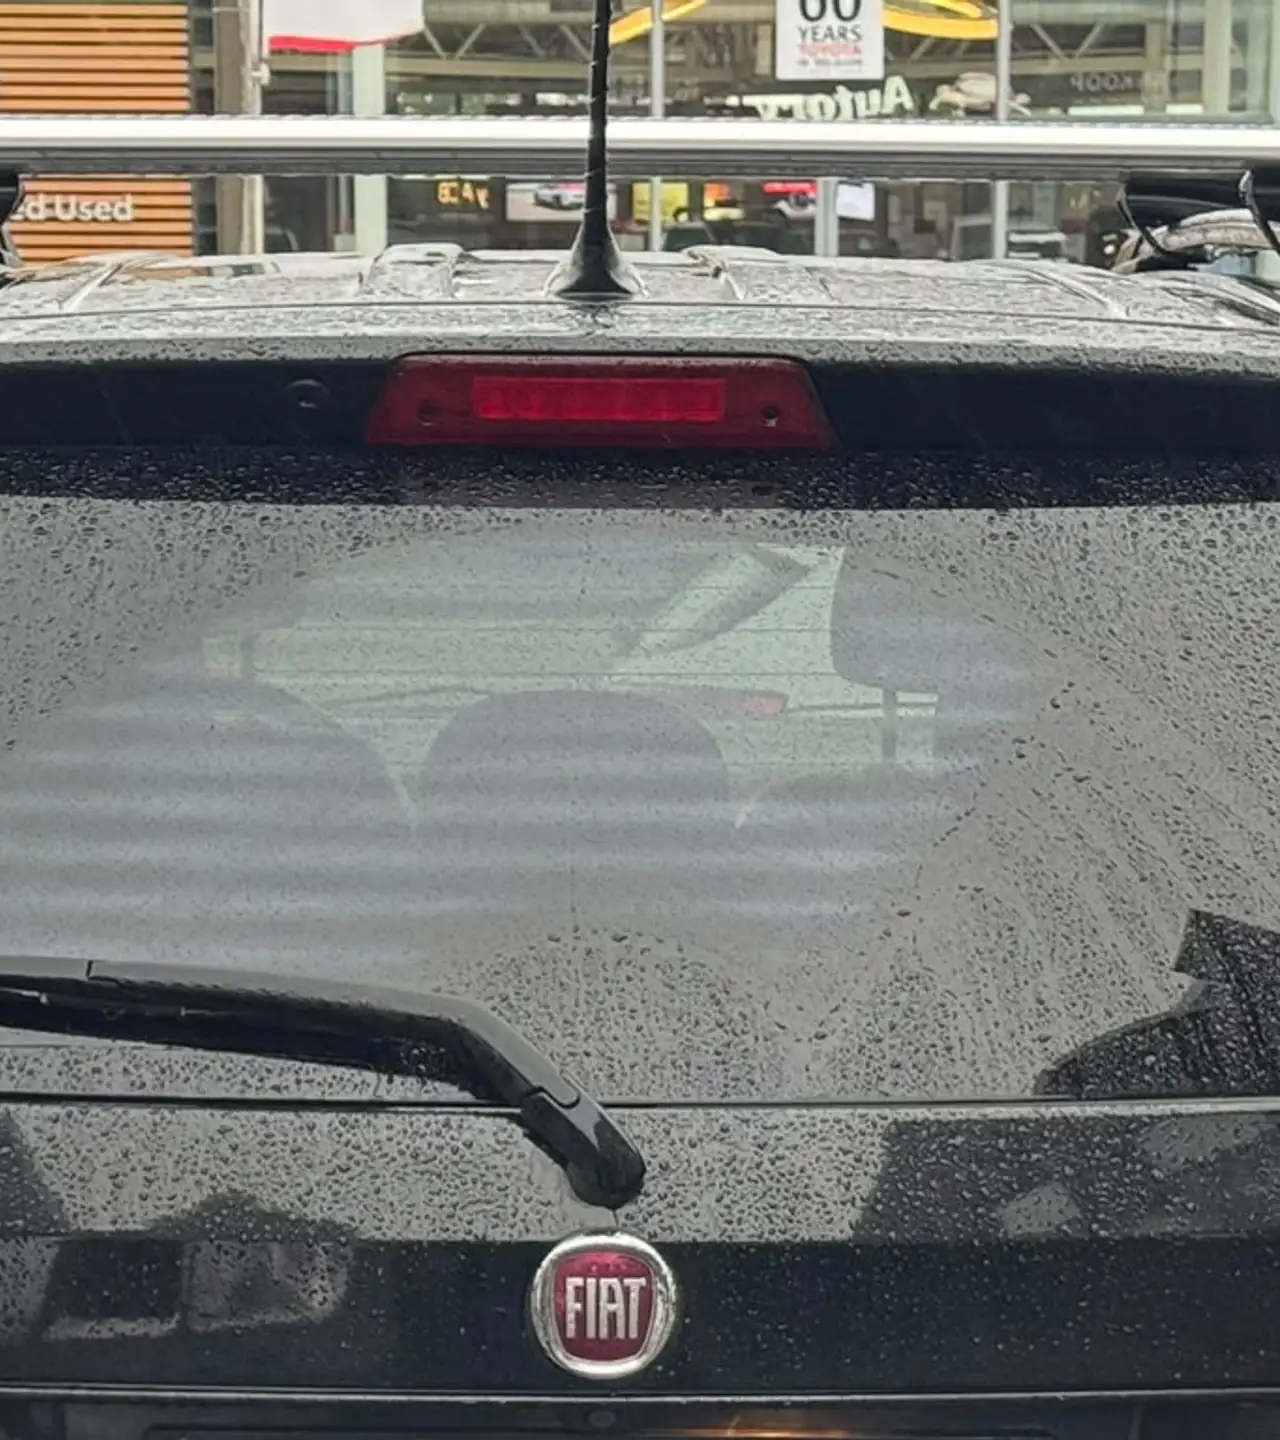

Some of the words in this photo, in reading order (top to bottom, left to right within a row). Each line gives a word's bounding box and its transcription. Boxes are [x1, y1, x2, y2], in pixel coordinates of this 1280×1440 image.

[797, 25, 862, 41] YEARS
[53, 194, 133, 222] Used
[565, 1277, 647, 1339] FIAT
